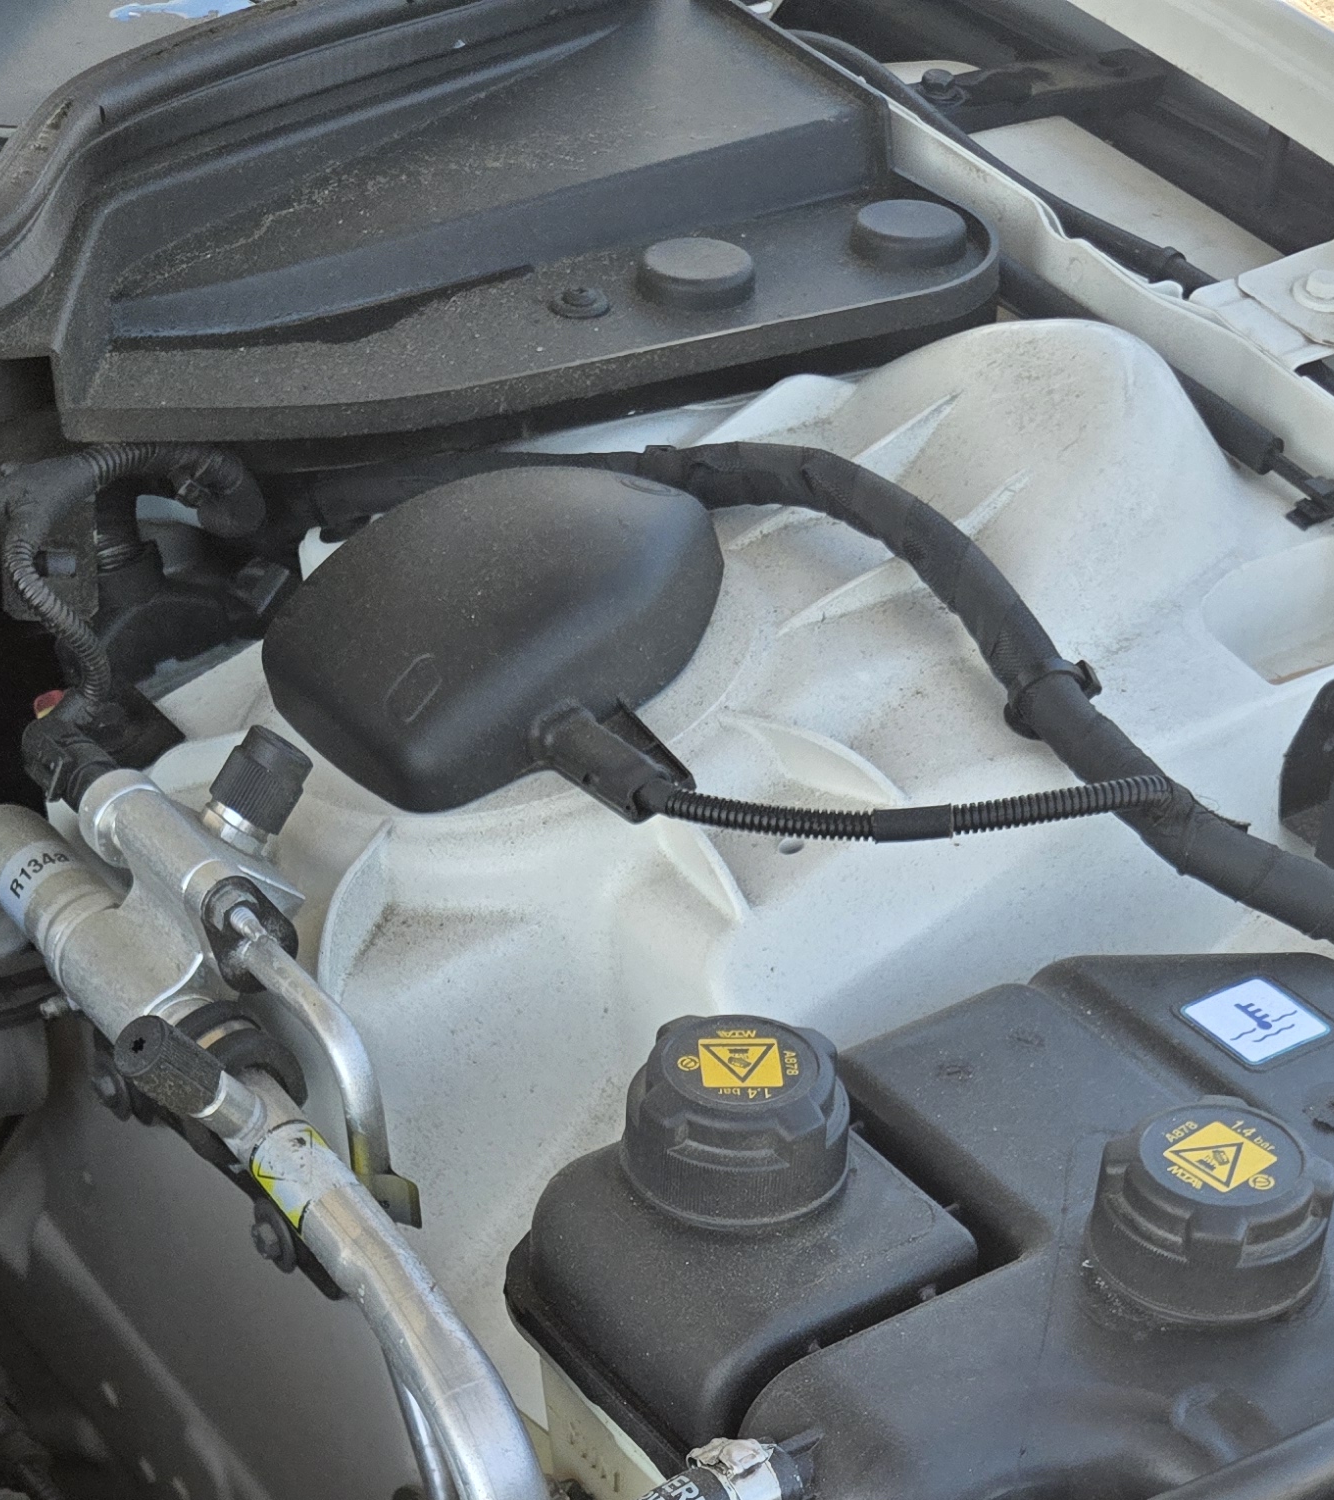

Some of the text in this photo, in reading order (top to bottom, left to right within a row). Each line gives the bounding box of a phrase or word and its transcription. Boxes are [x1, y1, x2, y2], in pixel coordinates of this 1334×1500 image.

[9, 852, 70, 899] R134a
[783, 1050, 799, 1076] A878
[718, 1087, 772, 1100] 1.4 bar
[1165, 1121, 1198, 1143] A878
[1231, 1120, 1276, 1151] 1.4 bar
